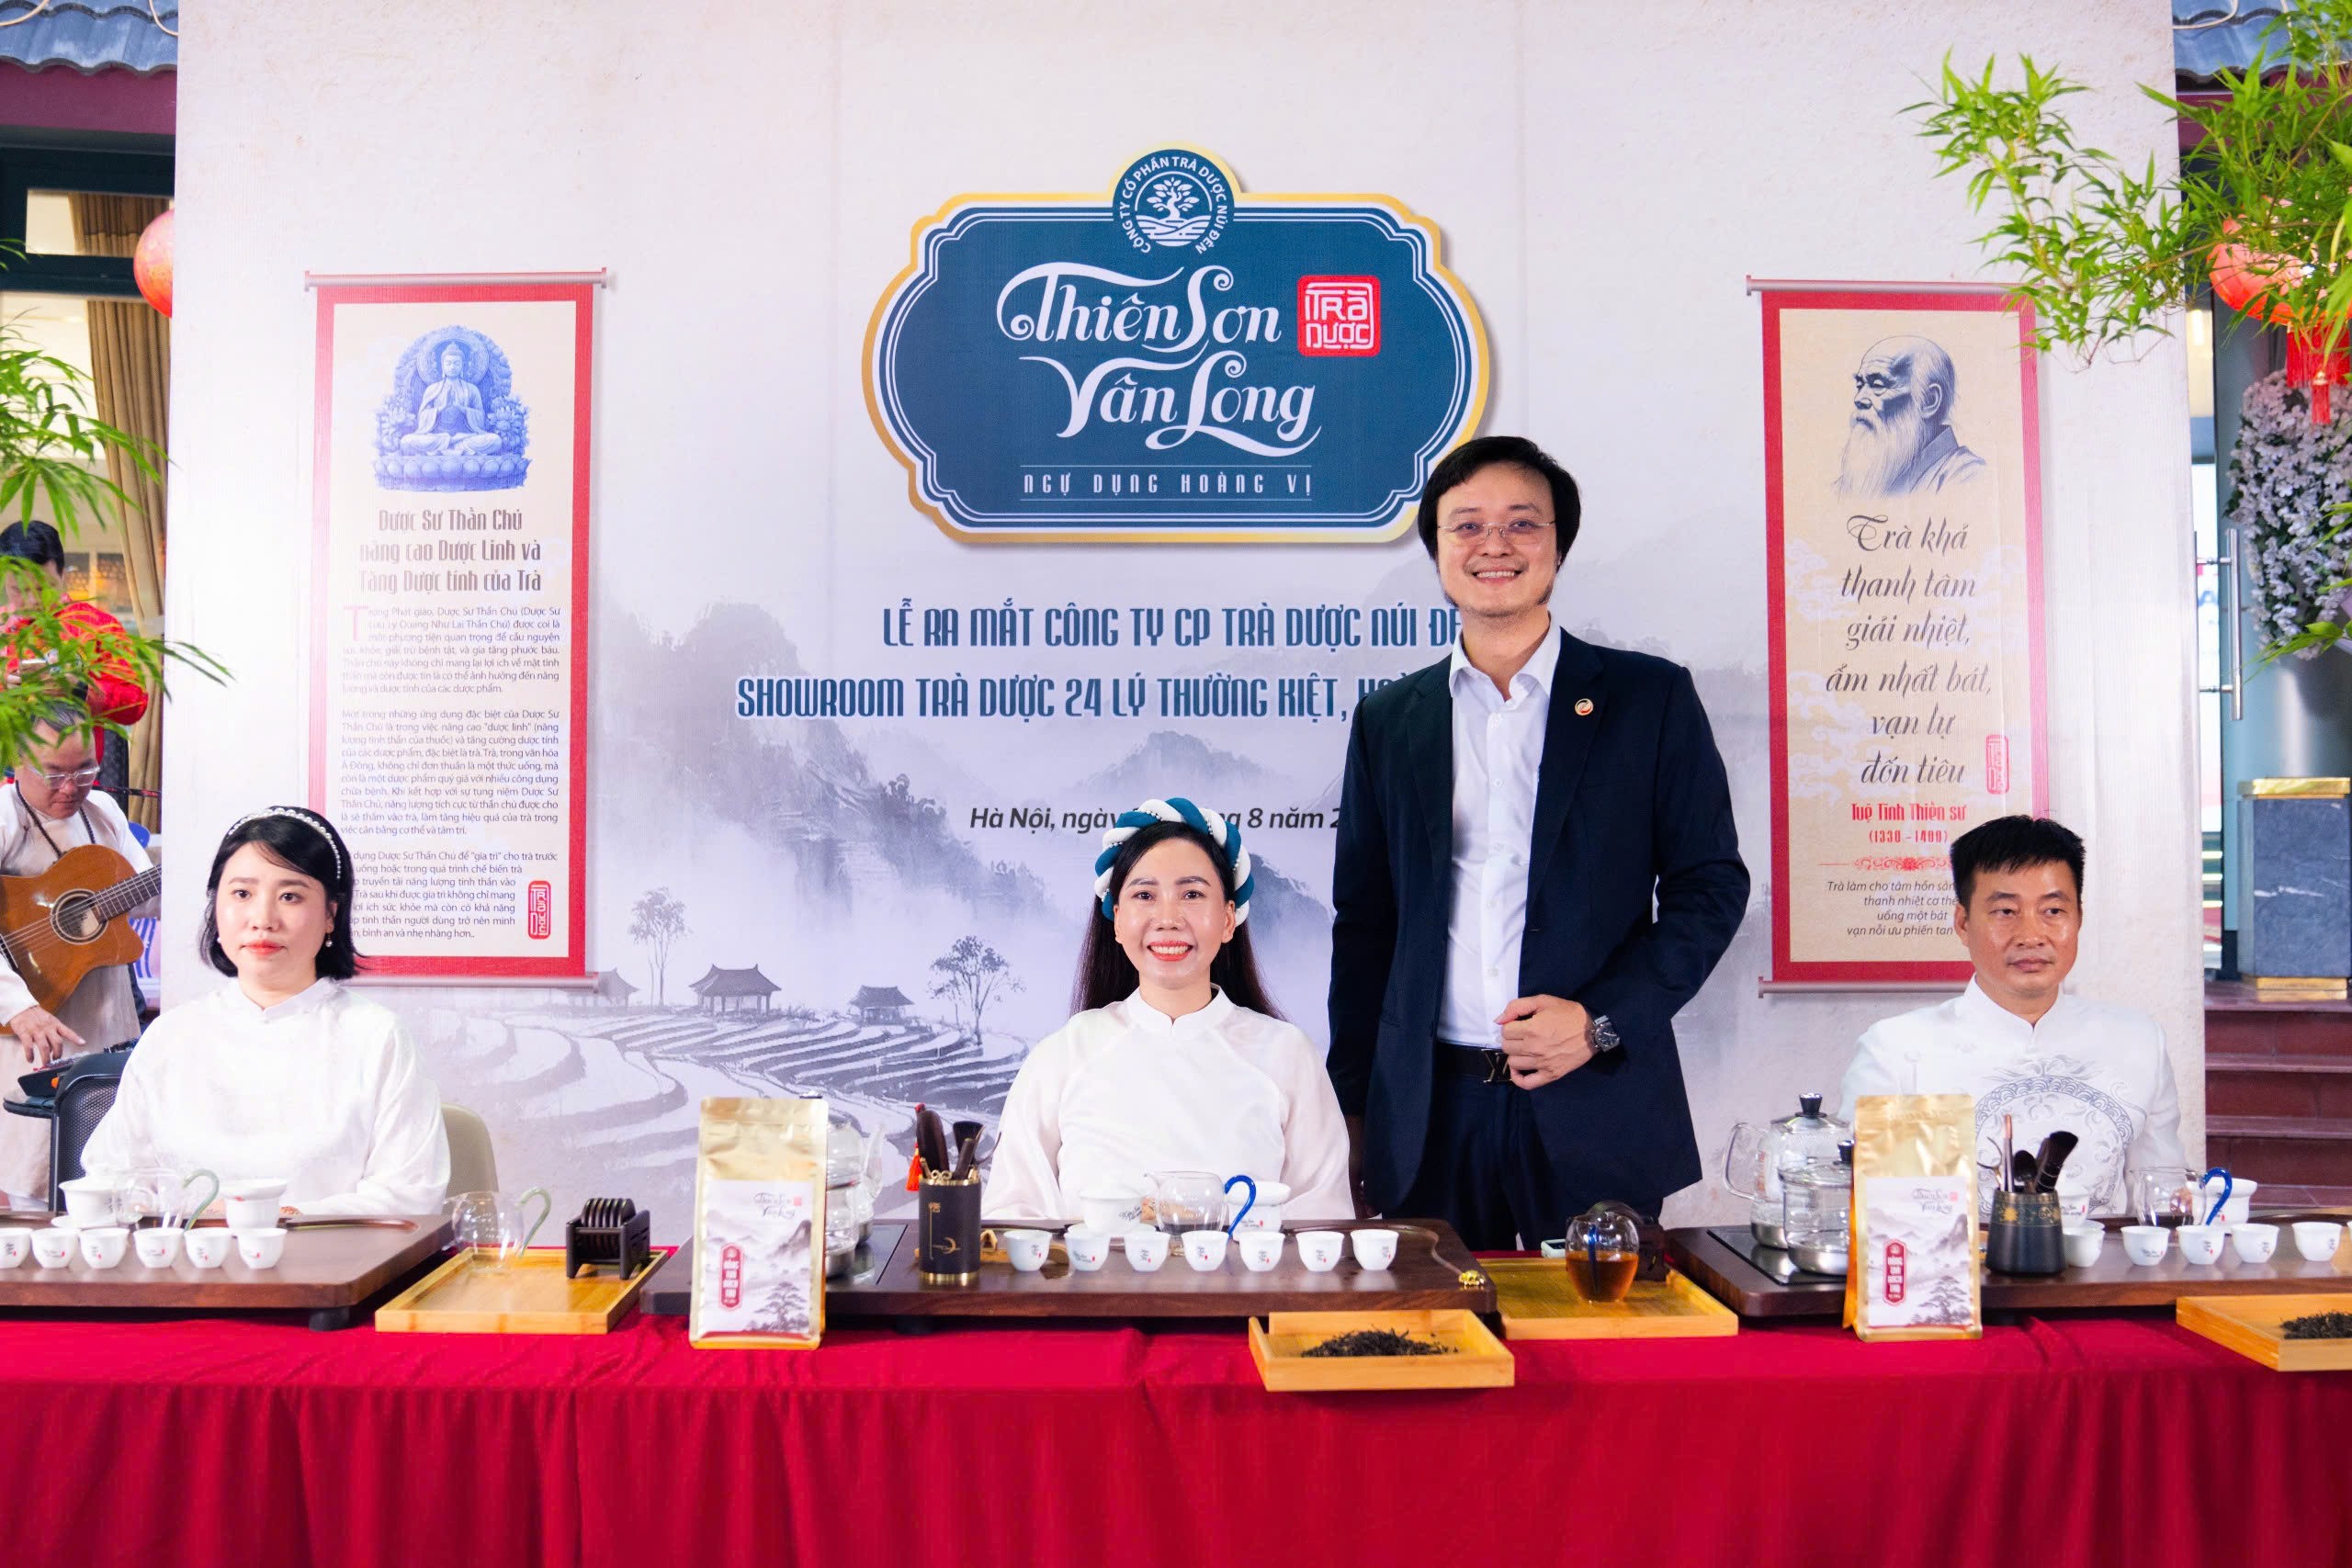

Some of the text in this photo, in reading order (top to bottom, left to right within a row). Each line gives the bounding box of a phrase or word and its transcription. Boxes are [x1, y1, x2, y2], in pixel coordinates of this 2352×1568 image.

[1120, 156, 1227, 254] CÔNG TY CỔ PHẦN TRÀ DƯỢC NÚI ĐÈN
[997, 262, 1282, 353] Thiên Sơn
[1306, 287, 1372, 321] TRÀ
[1306, 322, 1371, 349] DƯỢC
[1019, 339, 1321, 457] Vân Long
[1023, 469, 1311, 496] NGỰ DỤNG HOÀNG VỊ
[379, 507, 523, 532] Dược Sư Thần Chú
[1847, 514, 1969, 557] Trà khả
[406, 544, 434, 561] cao
[439, 540, 477, 564] Dược
[482, 540, 515, 561] Linh
[522, 540, 541, 561] và
[404, 570, 441, 595] Dược
[484, 569, 512, 592] của
[517, 570, 541, 592] Trà
[1841, 564, 1975, 604] thanh tâm
[884, 598, 913, 646] LỄ
[924, 609, 958, 646] RA
[971, 598, 1034, 646] MẮT
[1046, 603, 1118, 646] CÔNG
[1130, 609, 1163, 646] TY
[1175, 609, 1210, 646] CP
[1222, 603, 1274, 646] TRÀ
[1286, 604, 1361, 652] DƯỢC
[1372, 603, 1416, 646] NÚI
[1845, 610, 1969, 650] giải nhiệt,
[1826, 660, 1991, 698] ấm nhất bát,
[739, 679, 903, 716] SHOWROOM
[916, 672, 967, 716] TRÀ
[980, 674, 1054, 722] DƯỢC
[1066, 679, 1101, 716] 24
[1113, 672, 1145, 716] LÝ
[1158, 672, 1267, 716] THƯỜNG
[1279, 672, 1347, 723] KIỆT,
[1872, 702, 1955, 739] vạn lự
[1861, 750, 1906, 784] đốn
[1917, 755, 1965, 784] tiêu
[970, 808, 1003, 828] Hà
[1010, 808, 1055, 833] Nội,
[1248, 808, 1262, 828] 8
[1270, 807, 1323, 828] năm
[1851, 803, 1872, 823] Tuệ
[1877, 803, 1905, 820] Tĩnh
[1910, 801, 1945, 820] Thiền
[1869, 830, 1901, 843] (1330
[1915, 830, 1948, 843] 1400)
[1827, 882, 1844, 892] Trà
[1847, 881, 1866, 892] làm
[1870, 882, 1888, 892] cho
[1891, 882, 1912, 892] tâm
[1864, 897, 1894, 906] thanh
[1897, 897, 1924, 908] nhiệt
[1927, 897, 1939, 906] cơ
[1877, 910, 1948, 922] uống một bát
[1847, 929, 1866, 938] vạn
[1888, 927, 1901, 935] ưu
[1936, 926, 1953, 935] tan
